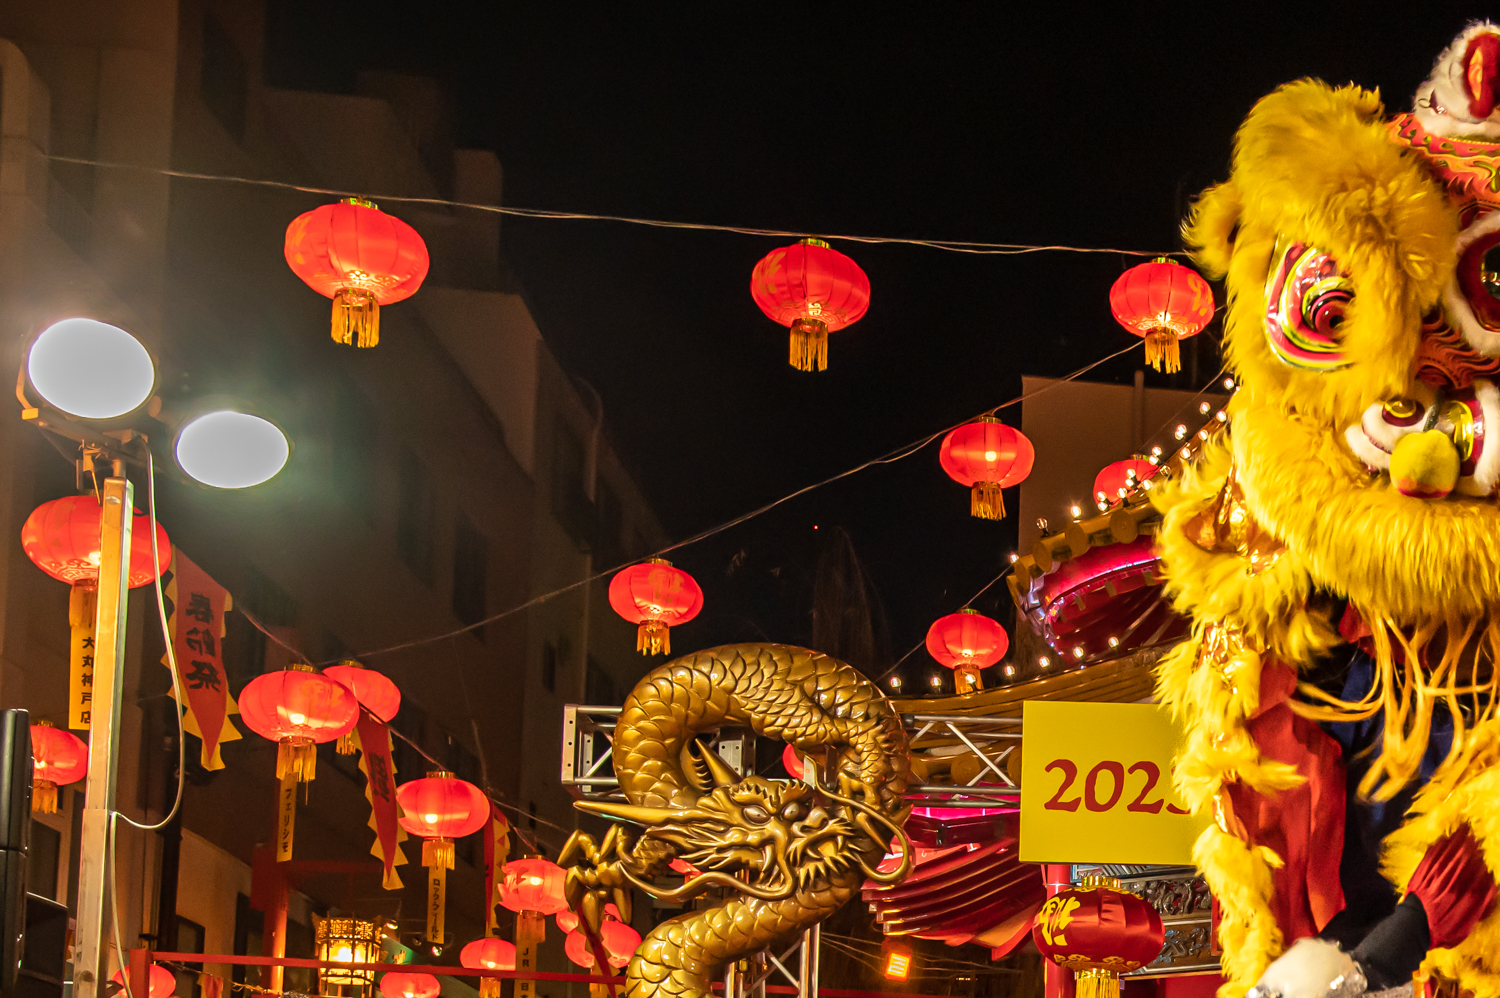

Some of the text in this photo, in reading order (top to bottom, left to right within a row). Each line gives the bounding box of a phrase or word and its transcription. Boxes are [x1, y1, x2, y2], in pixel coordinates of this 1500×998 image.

[1044, 758, 1192, 815] 202
[282, 788, 293, 853] フェリシモ
[431, 878, 441, 941] ロックフィールド
